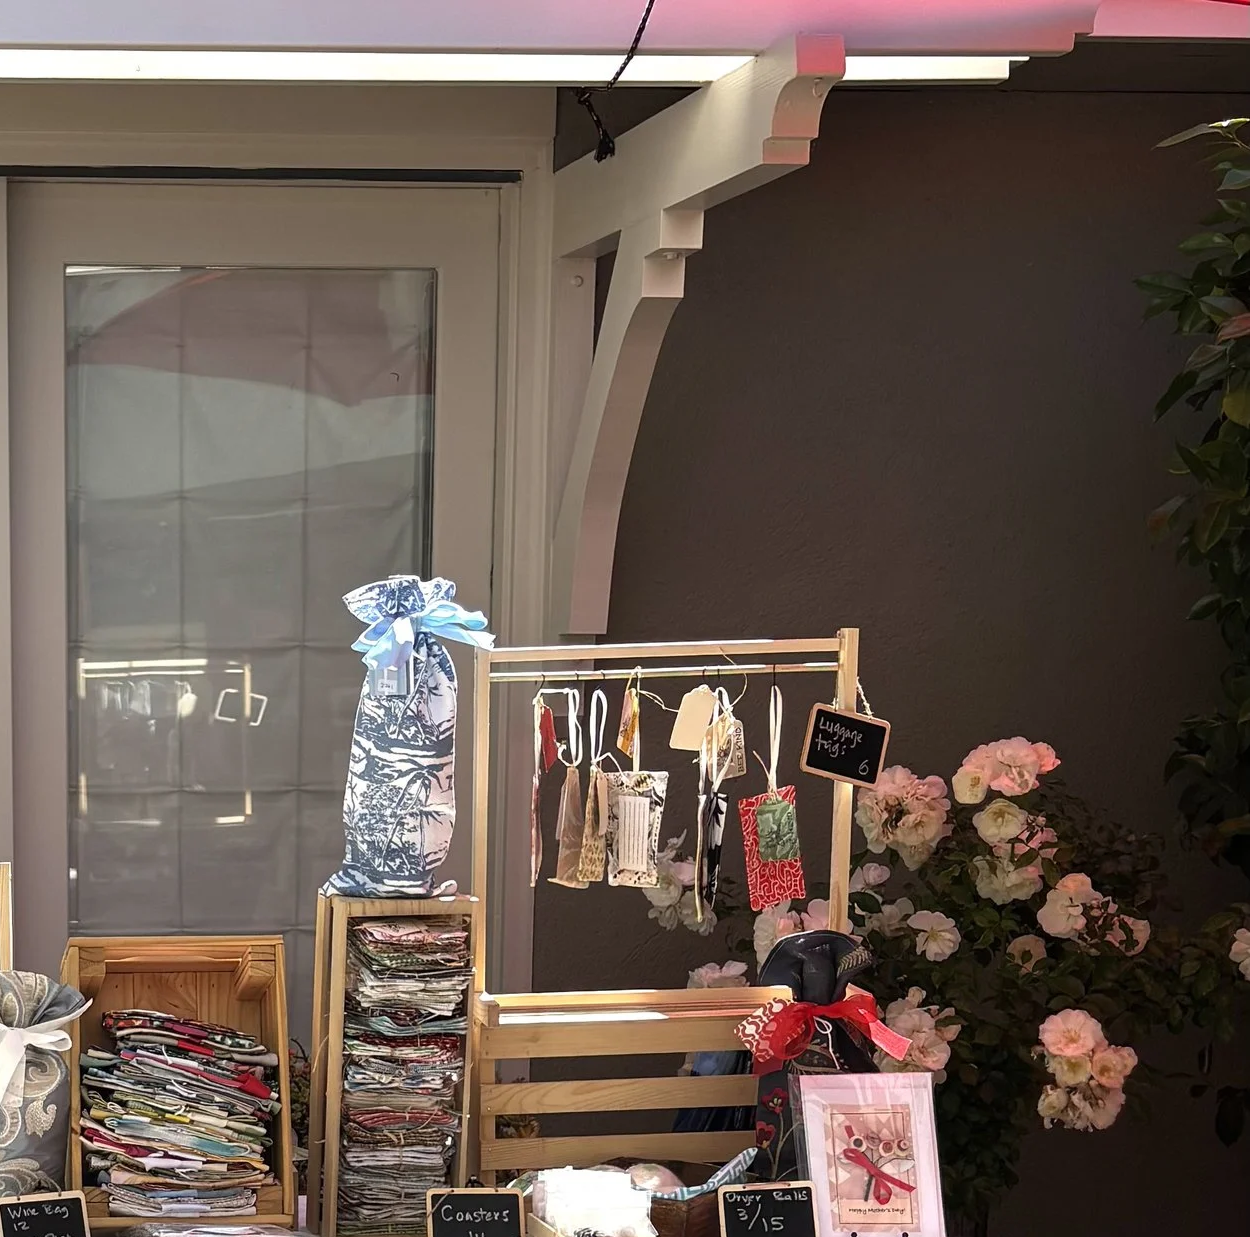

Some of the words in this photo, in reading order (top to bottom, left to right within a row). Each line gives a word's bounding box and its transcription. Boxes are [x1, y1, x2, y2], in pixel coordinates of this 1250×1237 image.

[819, 716, 863, 748] Luggage
[815, 733, 847, 758] tags
[858, 759, 869, 775] 6
[725, 1192, 762, 1206] Dryer
[772, 1190, 809, 1201] Balls
[7, 1205, 39, 1219] Wine
[41, 1203, 69, 1219] Bag
[441, 1204, 510, 1223] Coasters
[736, 1203, 784, 1232] 3/15
[13, 1221, 30, 1232] 12
